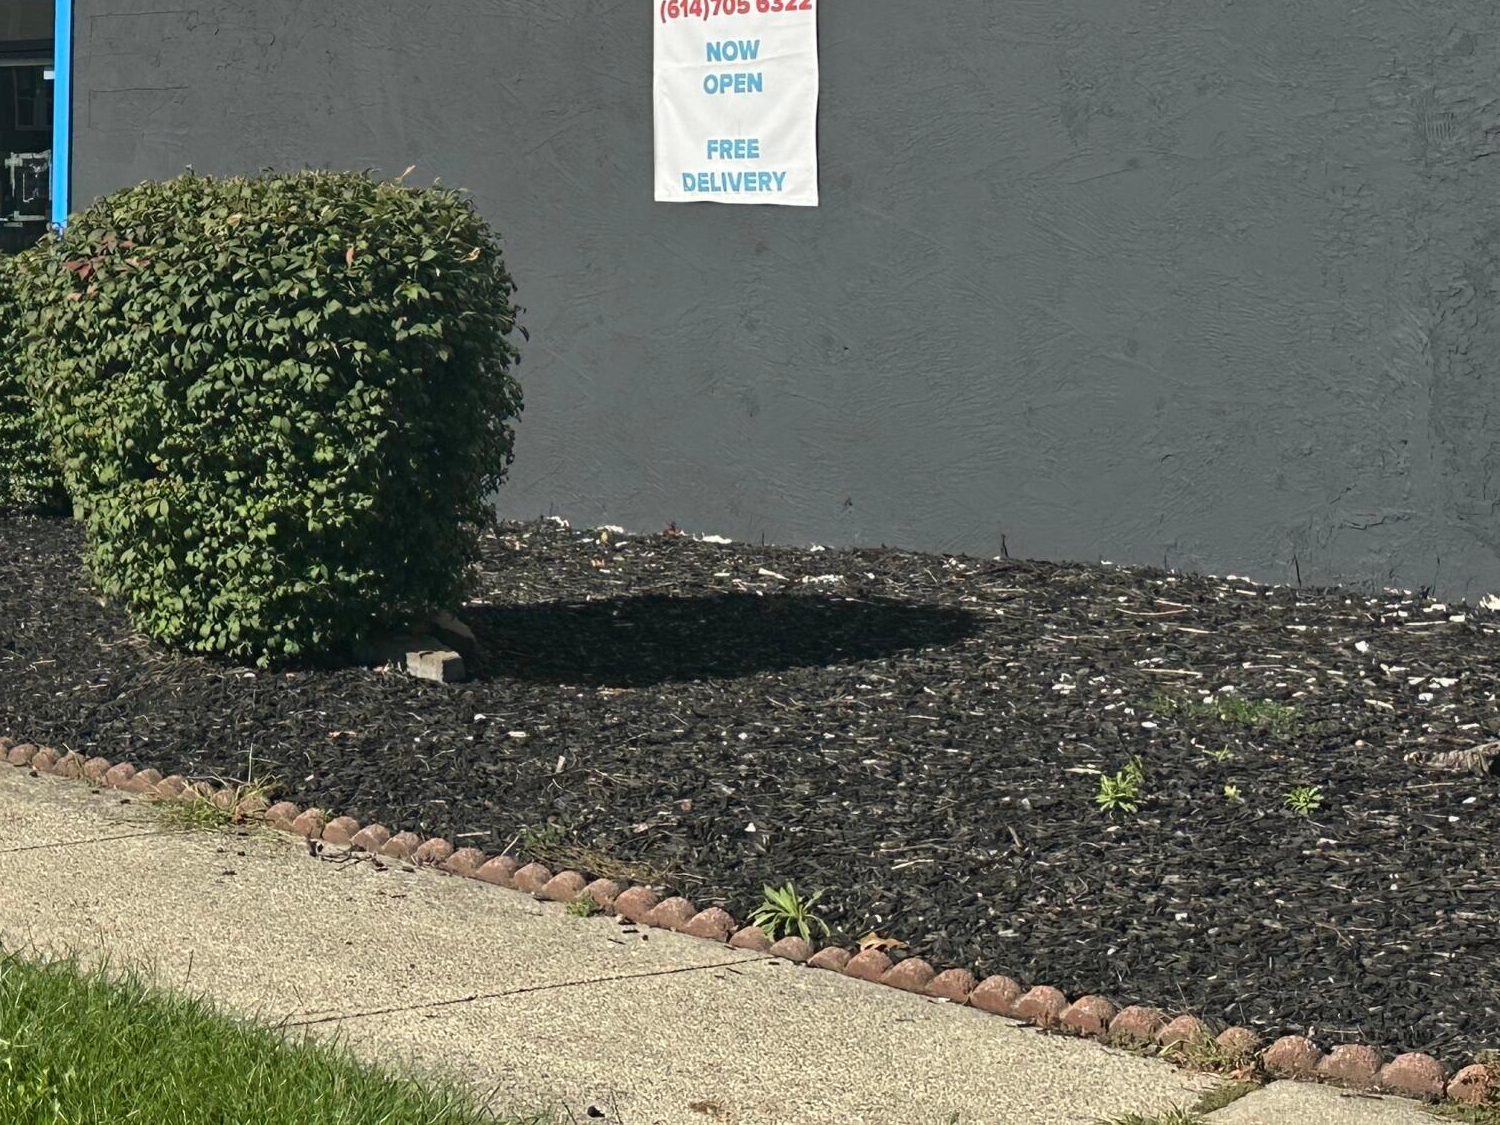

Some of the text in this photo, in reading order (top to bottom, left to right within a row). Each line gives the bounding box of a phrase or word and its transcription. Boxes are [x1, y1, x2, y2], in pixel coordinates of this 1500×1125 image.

[705, 39, 760, 62] NOW
[703, 72, 763, 94] OPEN
[706, 138, 760, 160] FREE
[682, 171, 787, 194] DELIVERY
